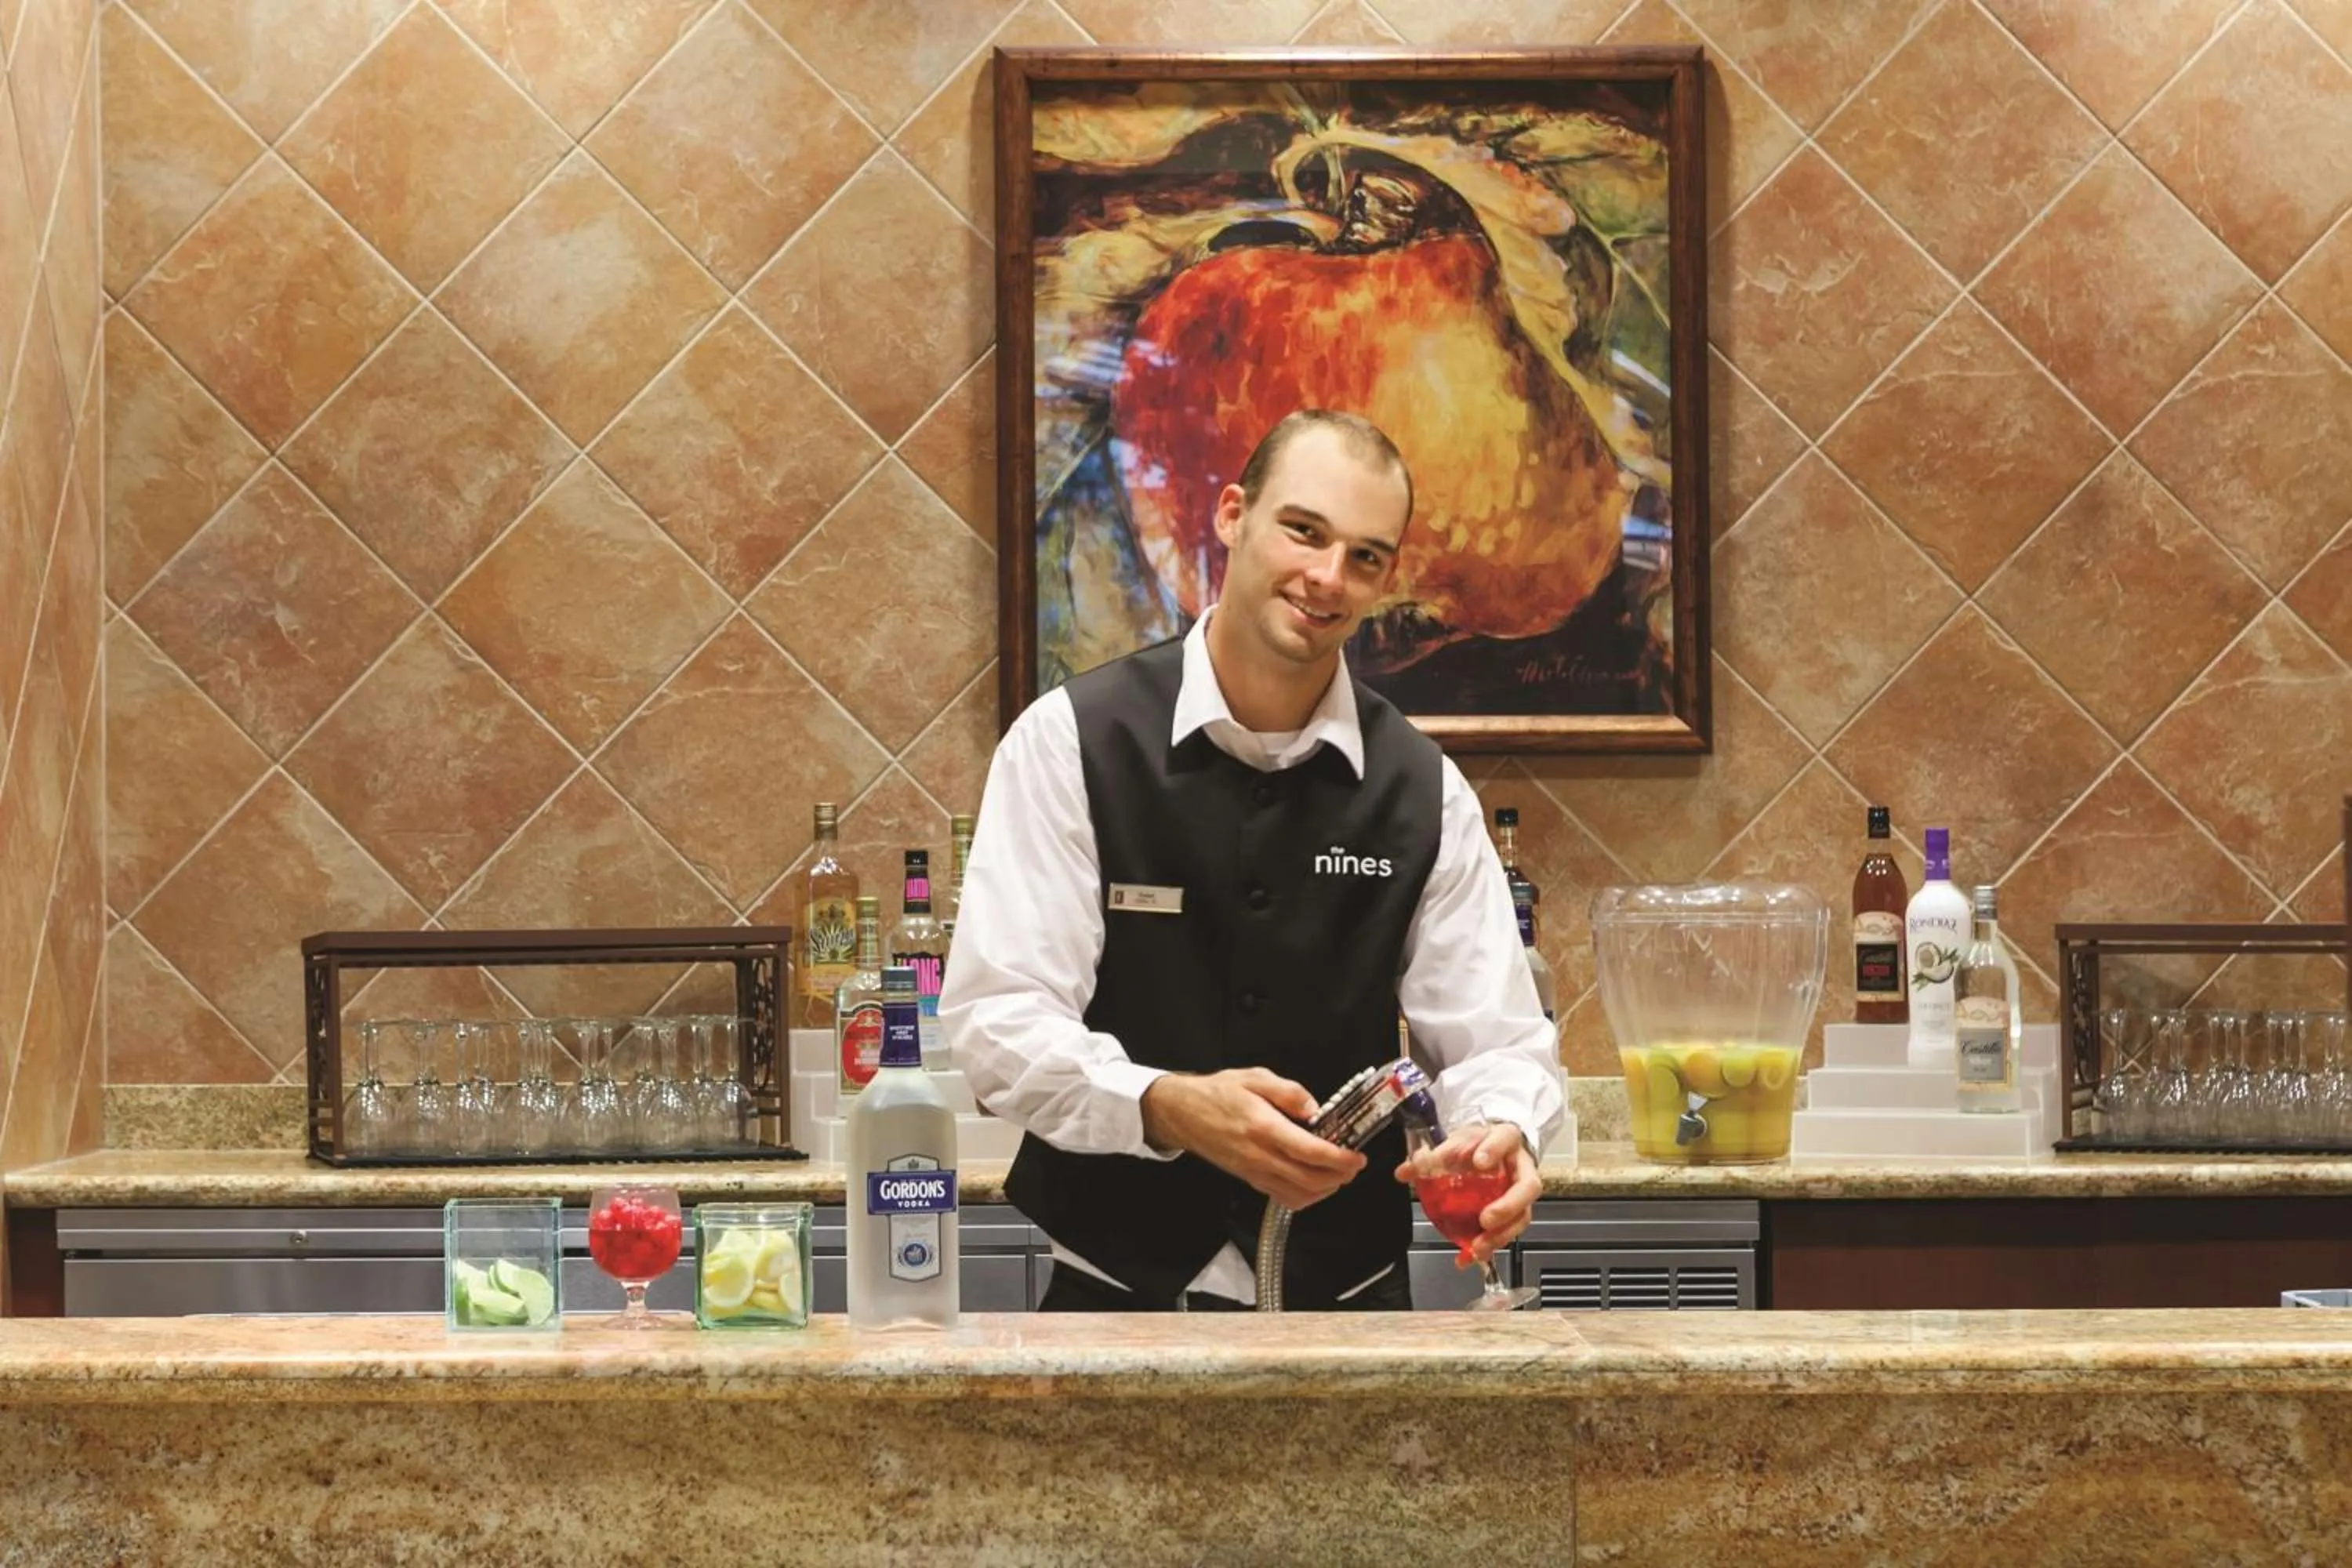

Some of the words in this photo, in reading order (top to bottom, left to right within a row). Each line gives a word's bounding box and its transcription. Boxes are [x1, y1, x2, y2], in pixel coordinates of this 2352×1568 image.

[1315, 855, 1392, 877] nines
[902, 957, 941, 995] ONG
[880, 1179, 946, 1200] GORDON'S
